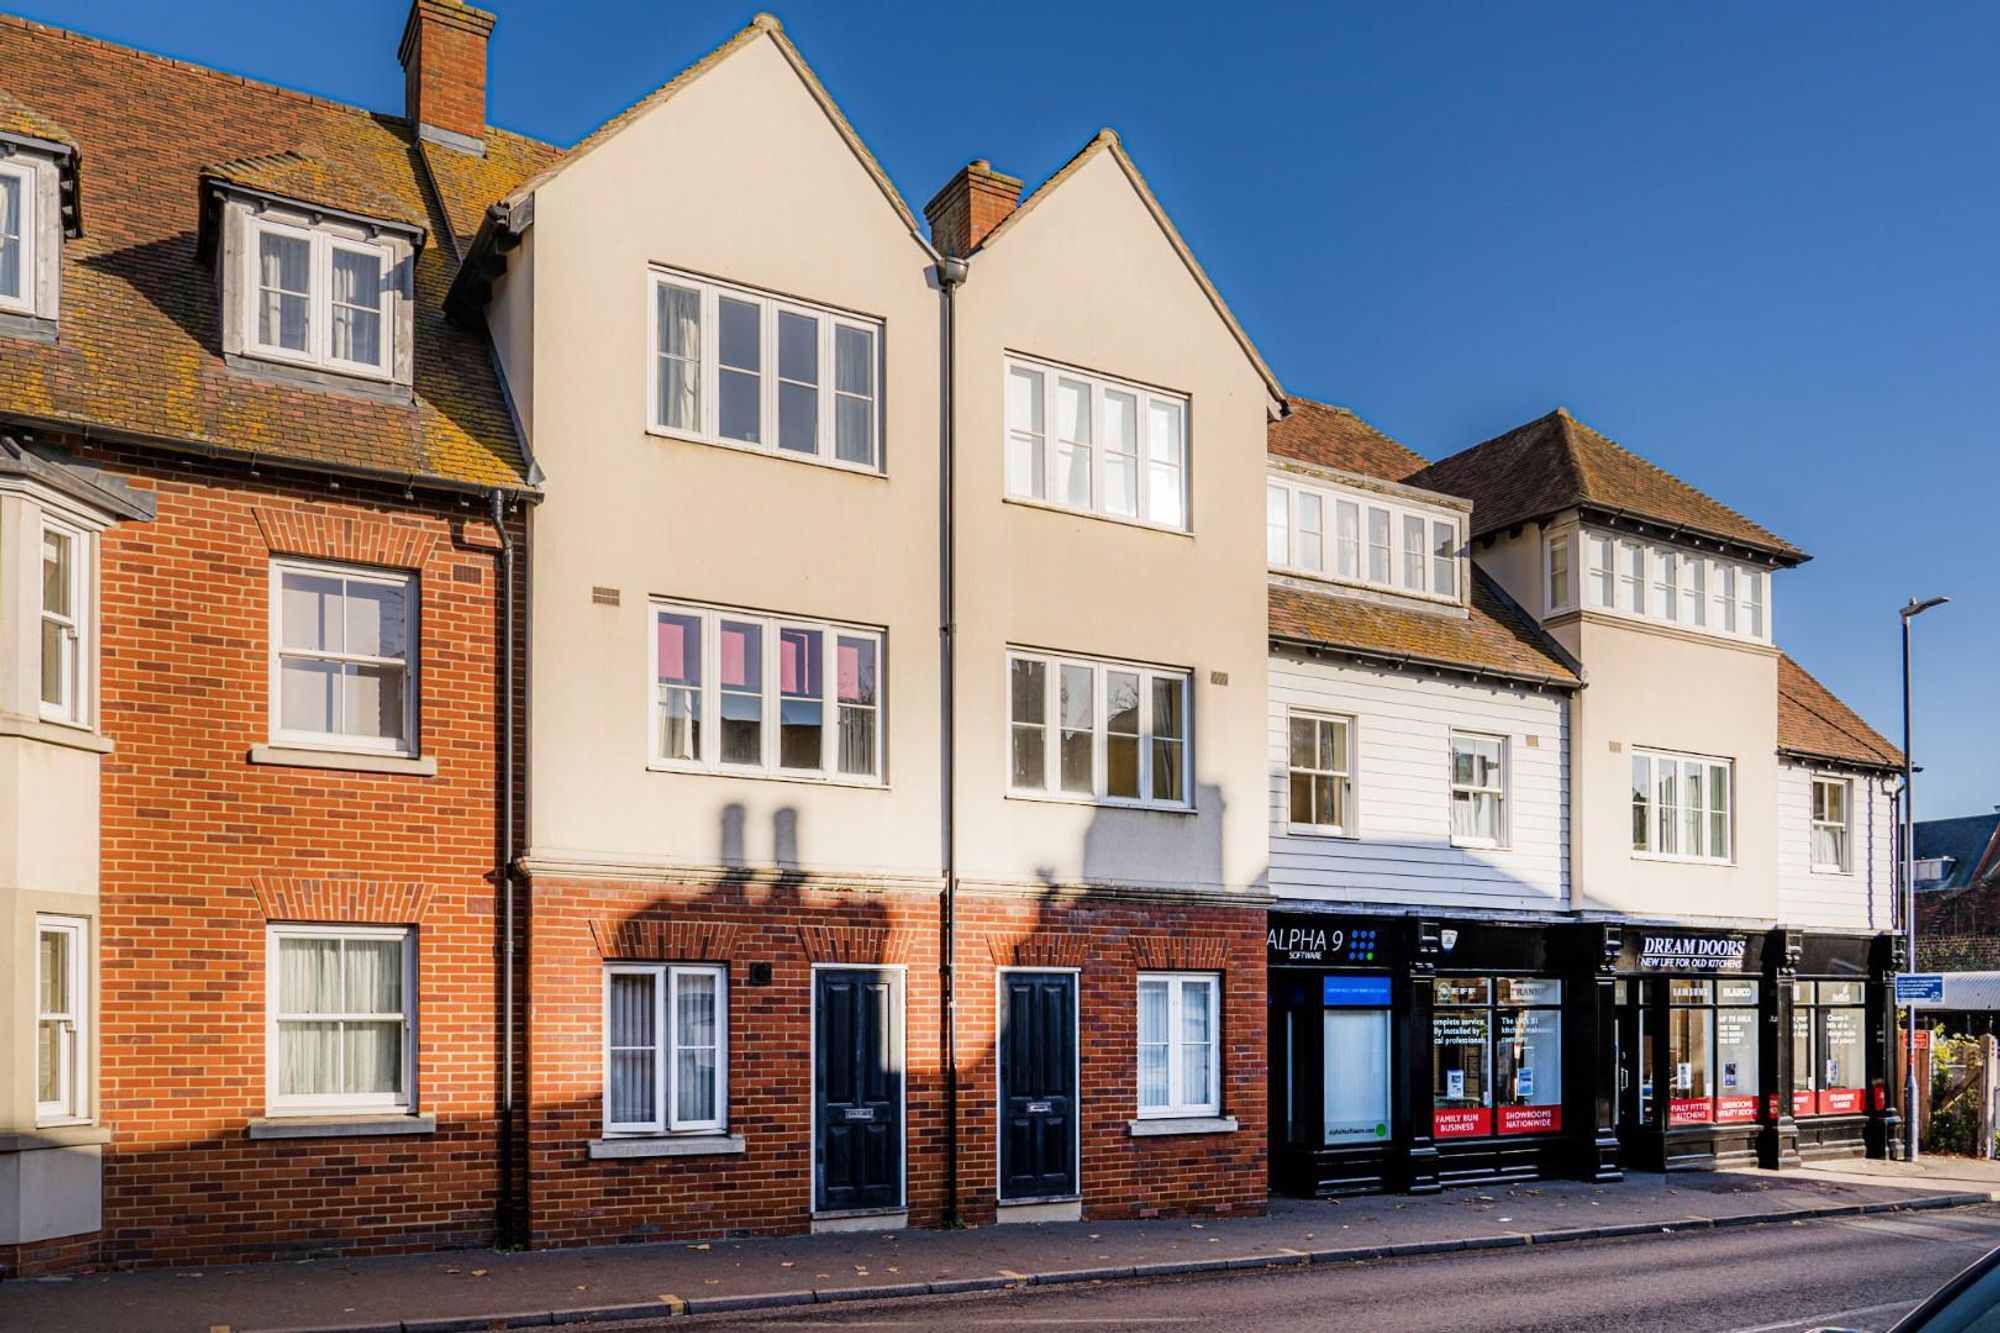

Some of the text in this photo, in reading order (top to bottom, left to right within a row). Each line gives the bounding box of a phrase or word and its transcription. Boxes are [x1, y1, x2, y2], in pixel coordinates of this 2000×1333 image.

[1266, 928, 1344, 952] ALPHA 9
[1643, 937, 1746, 956] DREAM DOORS
[1288, 951, 1323, 960] SOFTWARE
[1641, 957, 1743, 969] NEW LIFE FOR OLD KITCHENS
[1433, 1018, 1460, 1028] omplete
[1671, 1102, 1711, 1112] FULLY FITTED
[1435, 1113, 1479, 1124] FAMILY RUN
[1505, 1110, 1551, 1120] SHOWROOMS
[1676, 1111, 1706, 1120] KITCHENS
[1440, 1122, 1474, 1132] BUSINESS
[1506, 1118, 1551, 1129] NATIONWIDE
